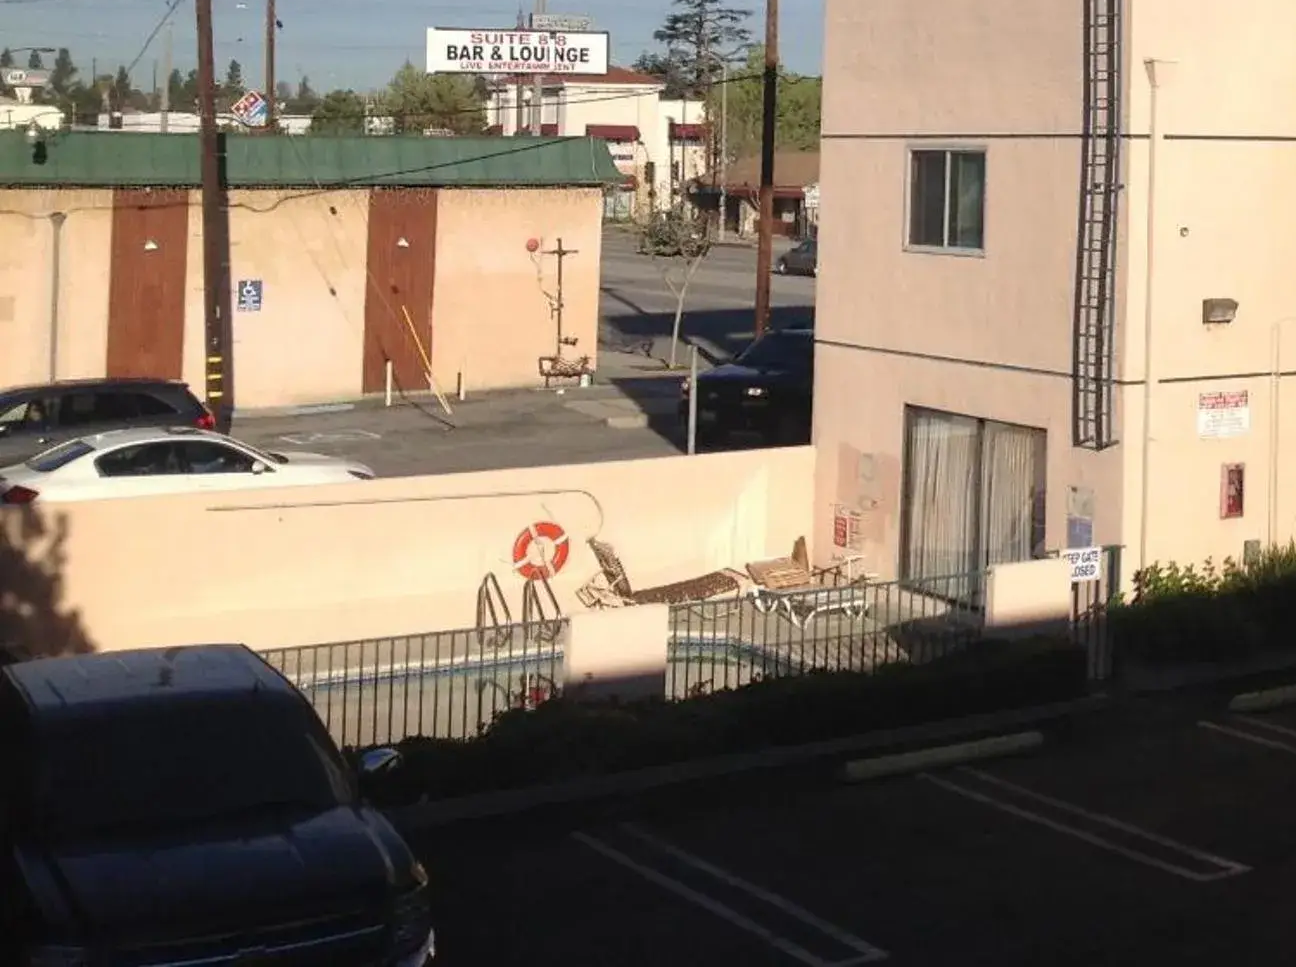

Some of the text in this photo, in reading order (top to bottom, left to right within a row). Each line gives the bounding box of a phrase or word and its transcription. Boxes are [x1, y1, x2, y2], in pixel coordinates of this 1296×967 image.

[470, 33, 532, 45] SUITE
[446, 45, 590, 63] BAR & LOUNGE
